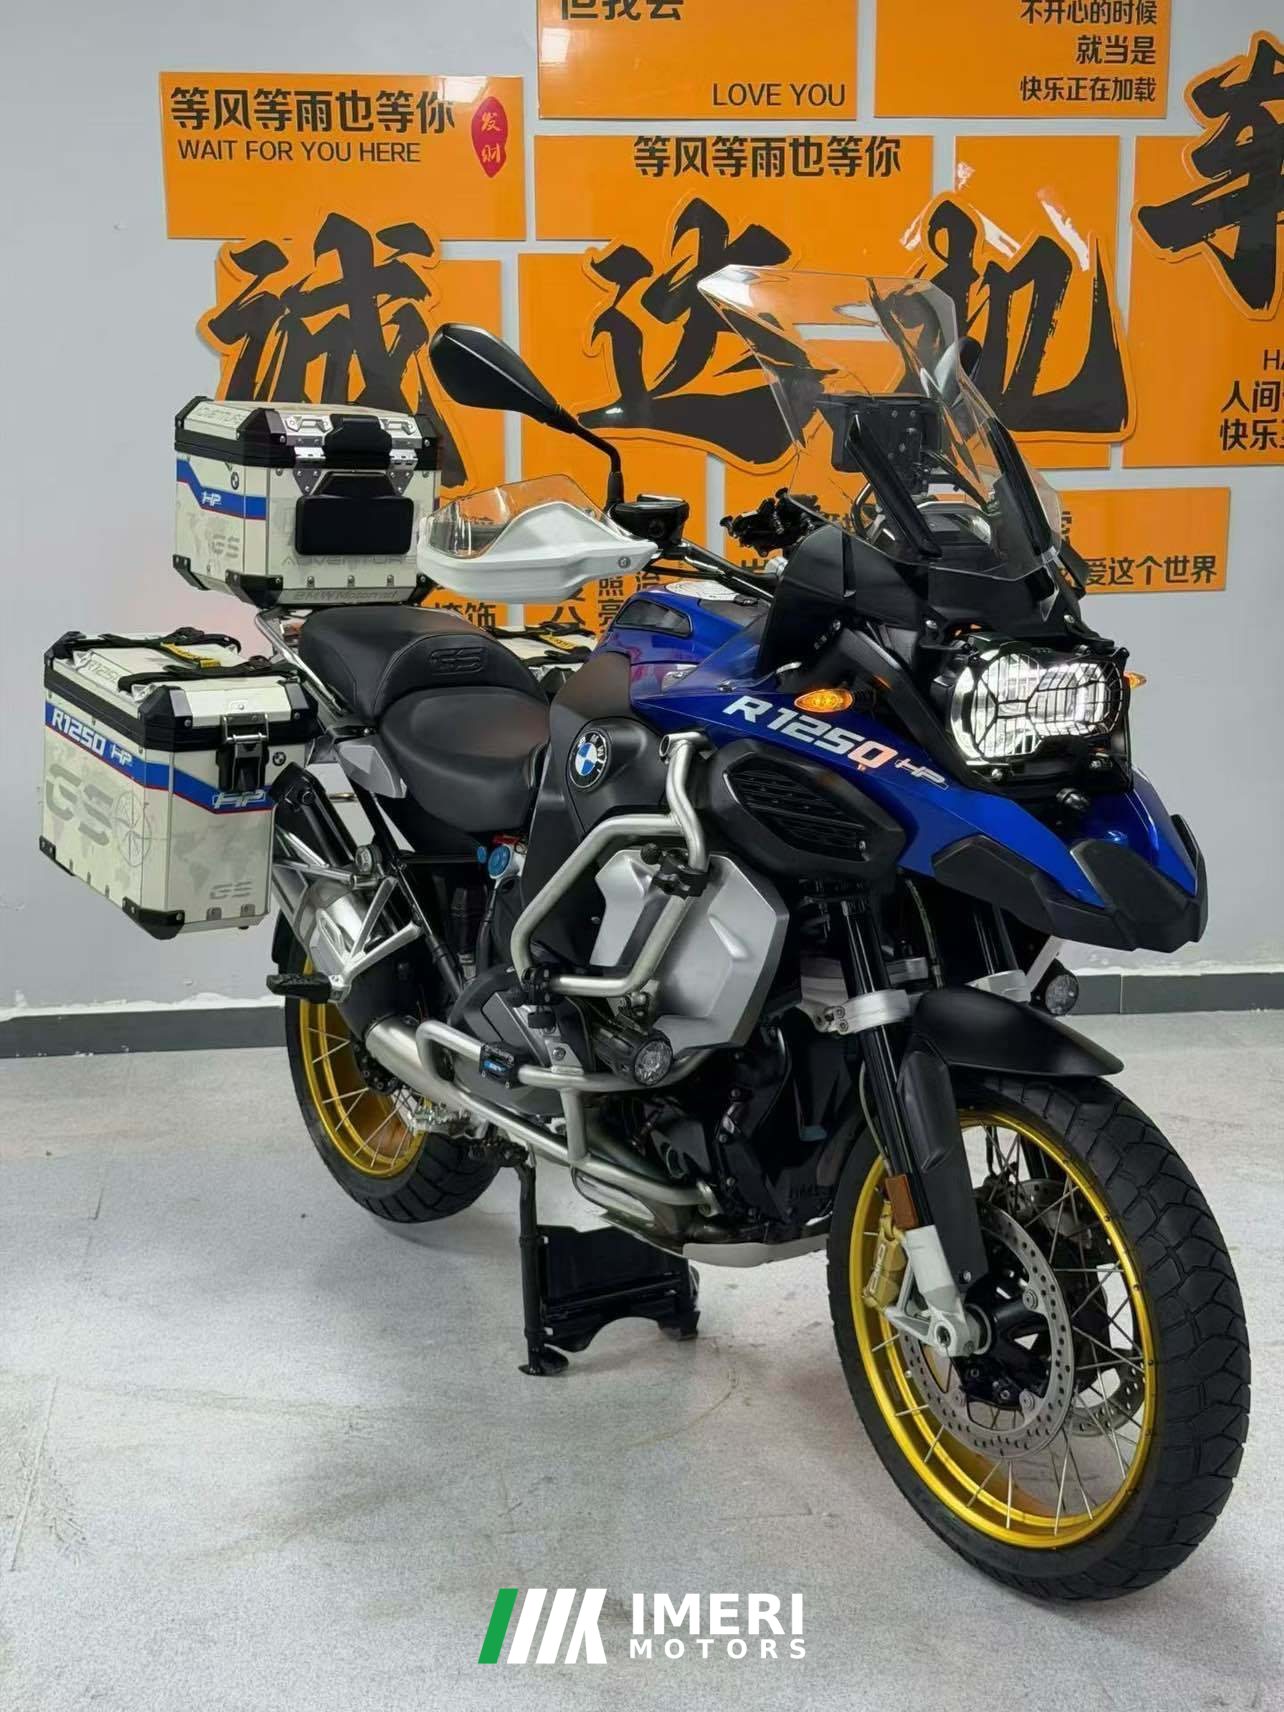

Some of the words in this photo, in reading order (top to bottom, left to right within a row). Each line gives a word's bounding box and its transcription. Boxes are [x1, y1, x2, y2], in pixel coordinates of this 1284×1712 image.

[1020, 0, 1157, 25] 不开心的时候
[1076, 34, 1156, 65] 就当是
[713, 83, 782, 106] LOVE
[790, 83, 846, 106] YOU
[1020, 75, 1157, 102] 快乐正在加载
[171, 87, 455, 135] 等风等雨也等你
[178, 139, 238, 160] WAIT
[246, 141, 292, 161] FOR
[301, 142, 351, 163] YOU
[359, 142, 421, 163] HERE
[633, 135, 901, 178] 等风等雨也等你
[1263, 349, 1284, 371] H
[1221, 380, 1284, 413] 人间
[1220, 418, 1284, 450] 快乐
[52, 708, 107, 757] R1250
[110, 744, 134, 767] HP
[723, 695, 768, 724] R
[766, 707, 898, 769] 1250
